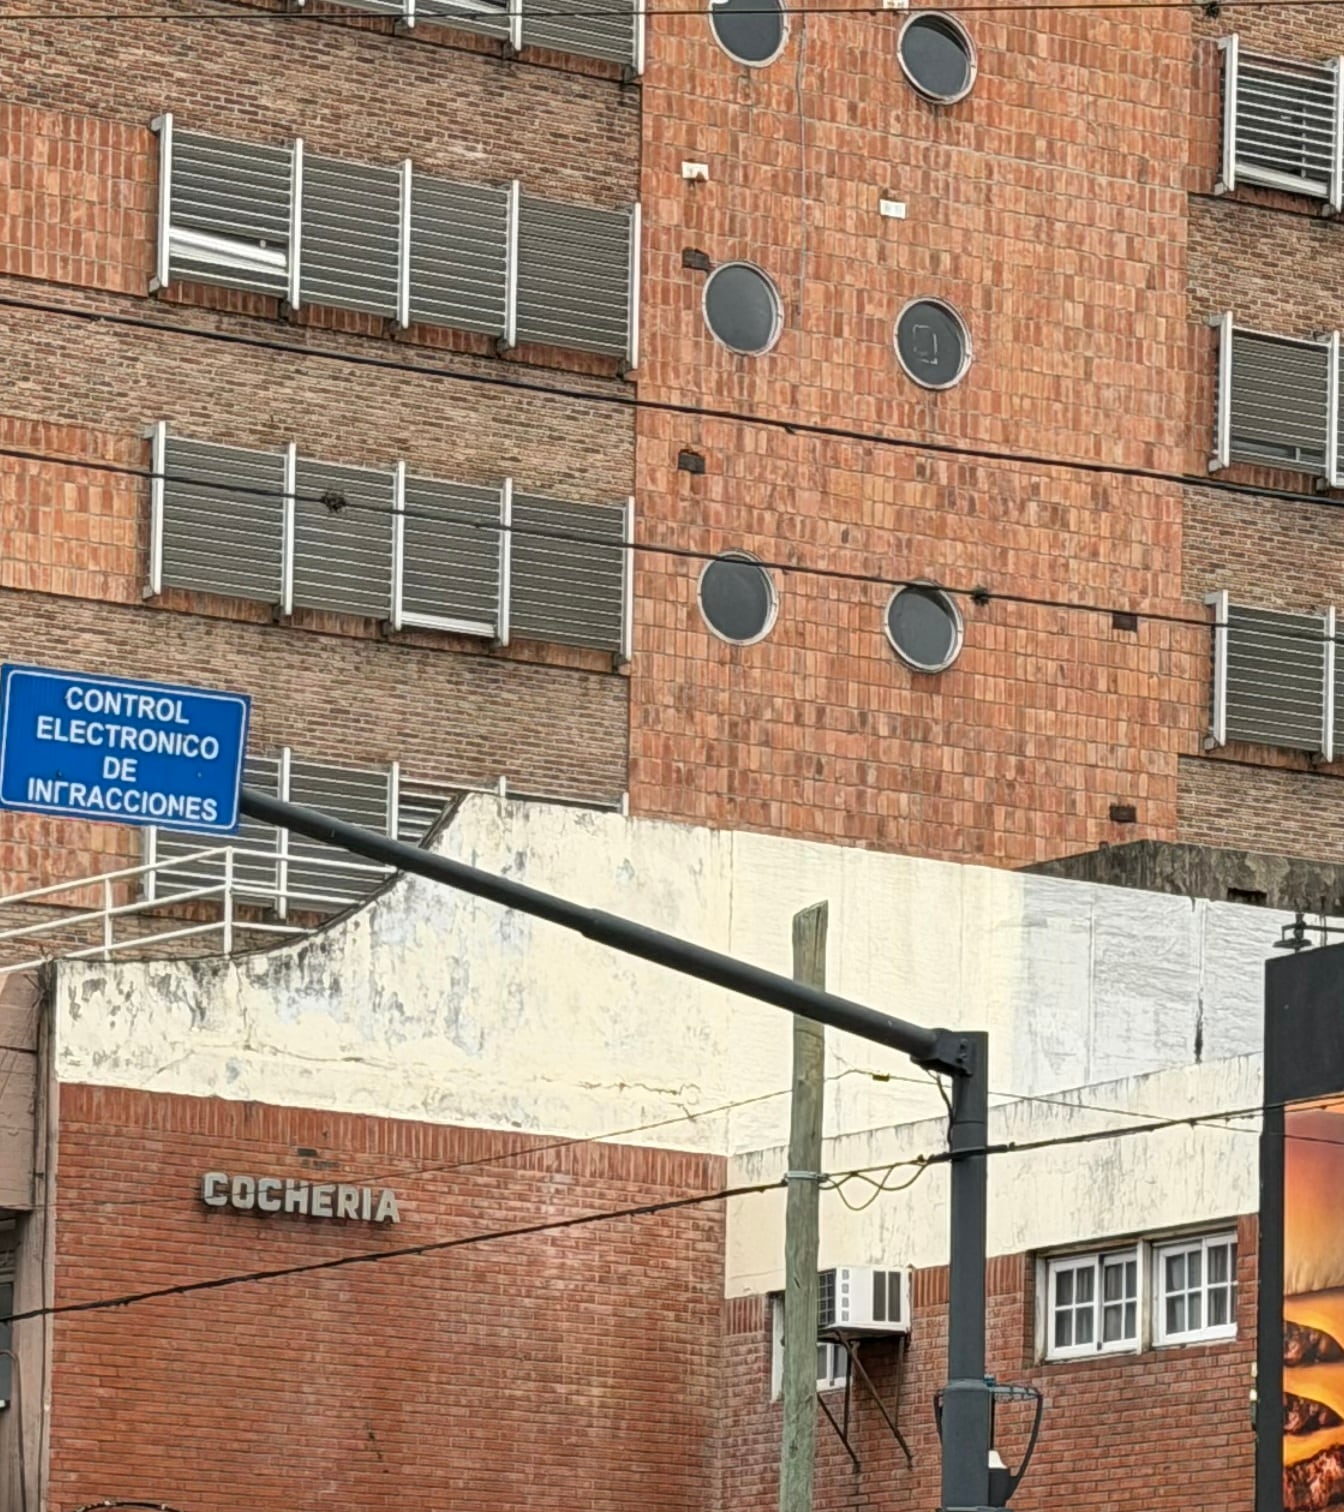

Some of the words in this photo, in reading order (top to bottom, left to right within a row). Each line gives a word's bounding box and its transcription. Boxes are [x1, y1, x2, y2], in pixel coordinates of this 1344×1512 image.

[65, 686, 190, 725] CONTROL
[36, 715, 219, 760] ELECTRONICO
[103, 756, 138, 782] DE
[27, 777, 218, 822] INFRACCIONES
[203, 1172, 401, 1223] COCHERIA
